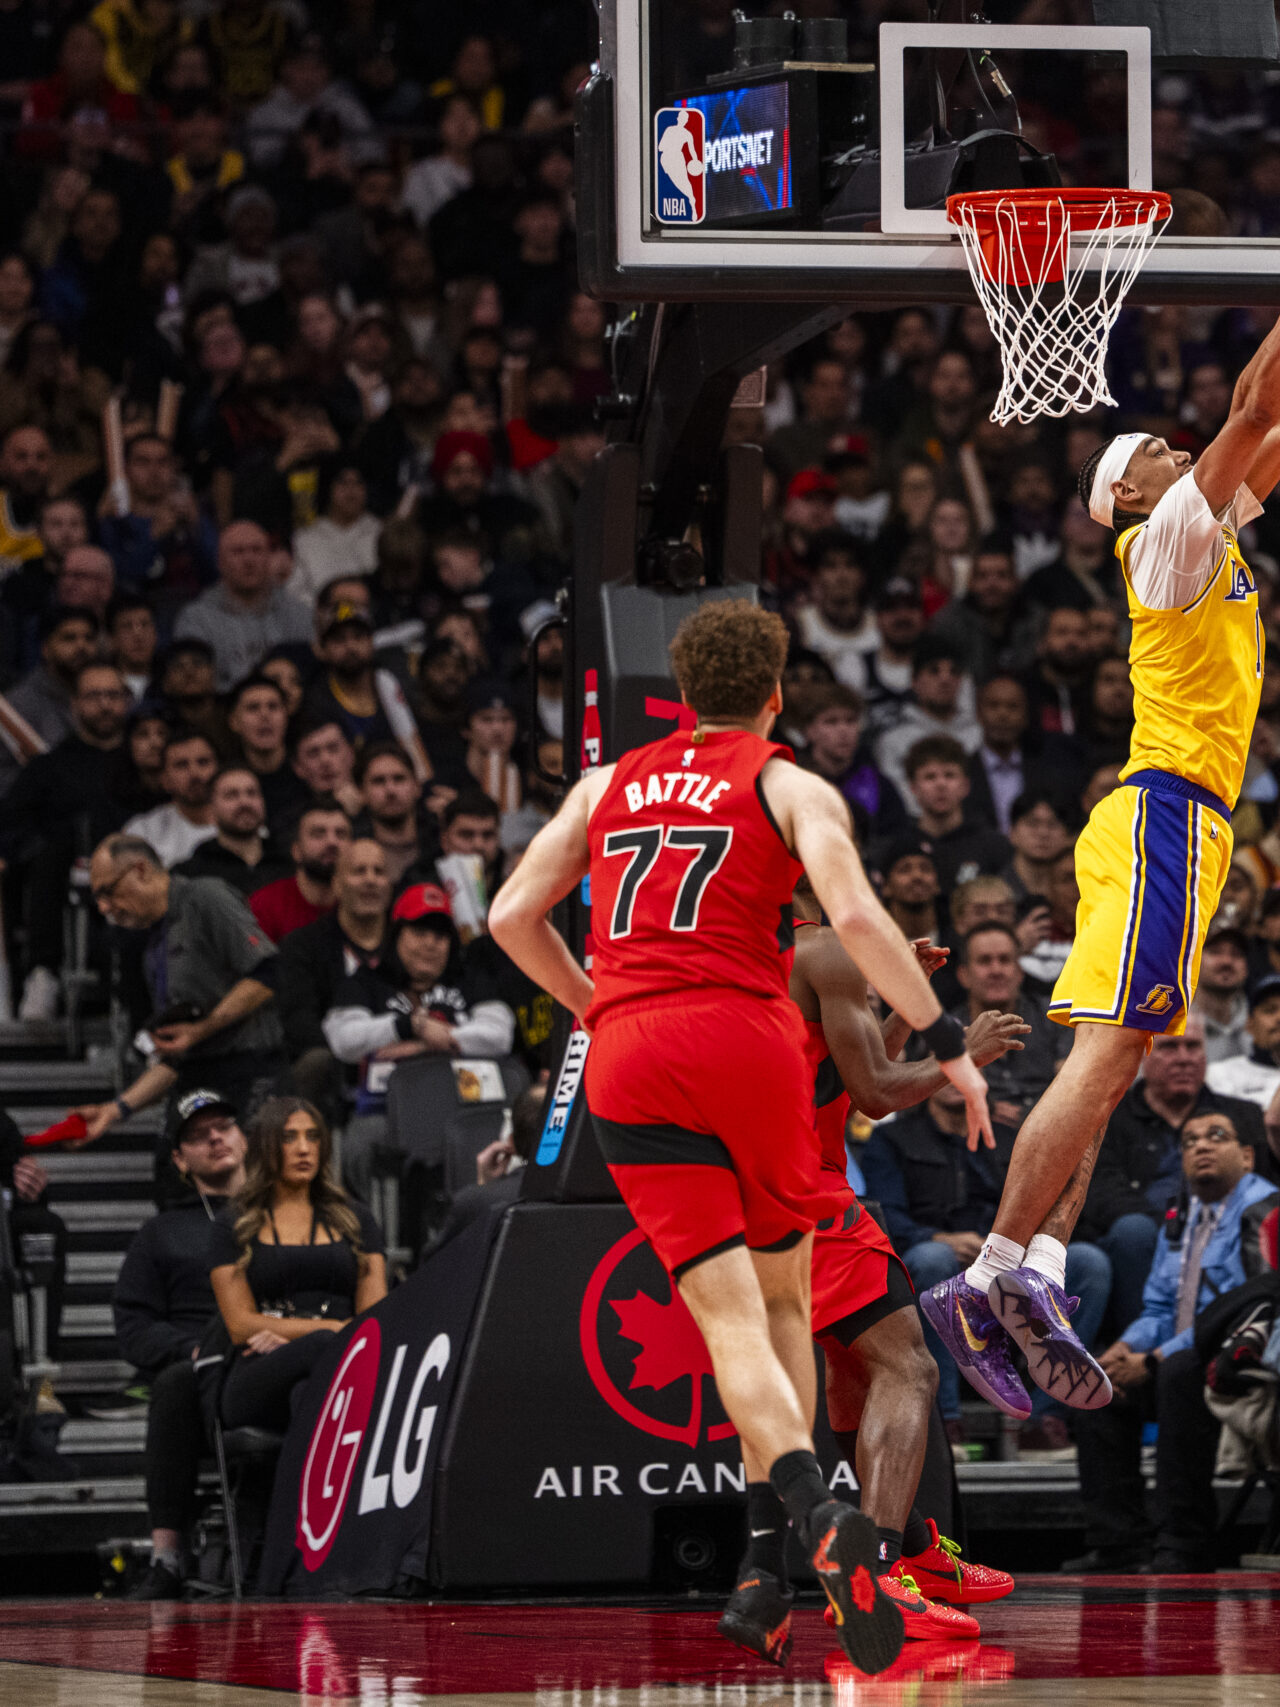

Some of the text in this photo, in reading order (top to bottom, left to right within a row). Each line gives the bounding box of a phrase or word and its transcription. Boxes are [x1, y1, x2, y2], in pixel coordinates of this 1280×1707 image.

[704, 130, 774, 174] PORTSNET
[663, 198, 687, 216] NBA
[625, 772, 731, 813] BATTLE
[603, 824, 733, 940] 77
[549, 1031, 591, 1132] RIME
[358, 1333, 450, 1516] LG
[534, 1460, 860, 1498] AIR CANA
